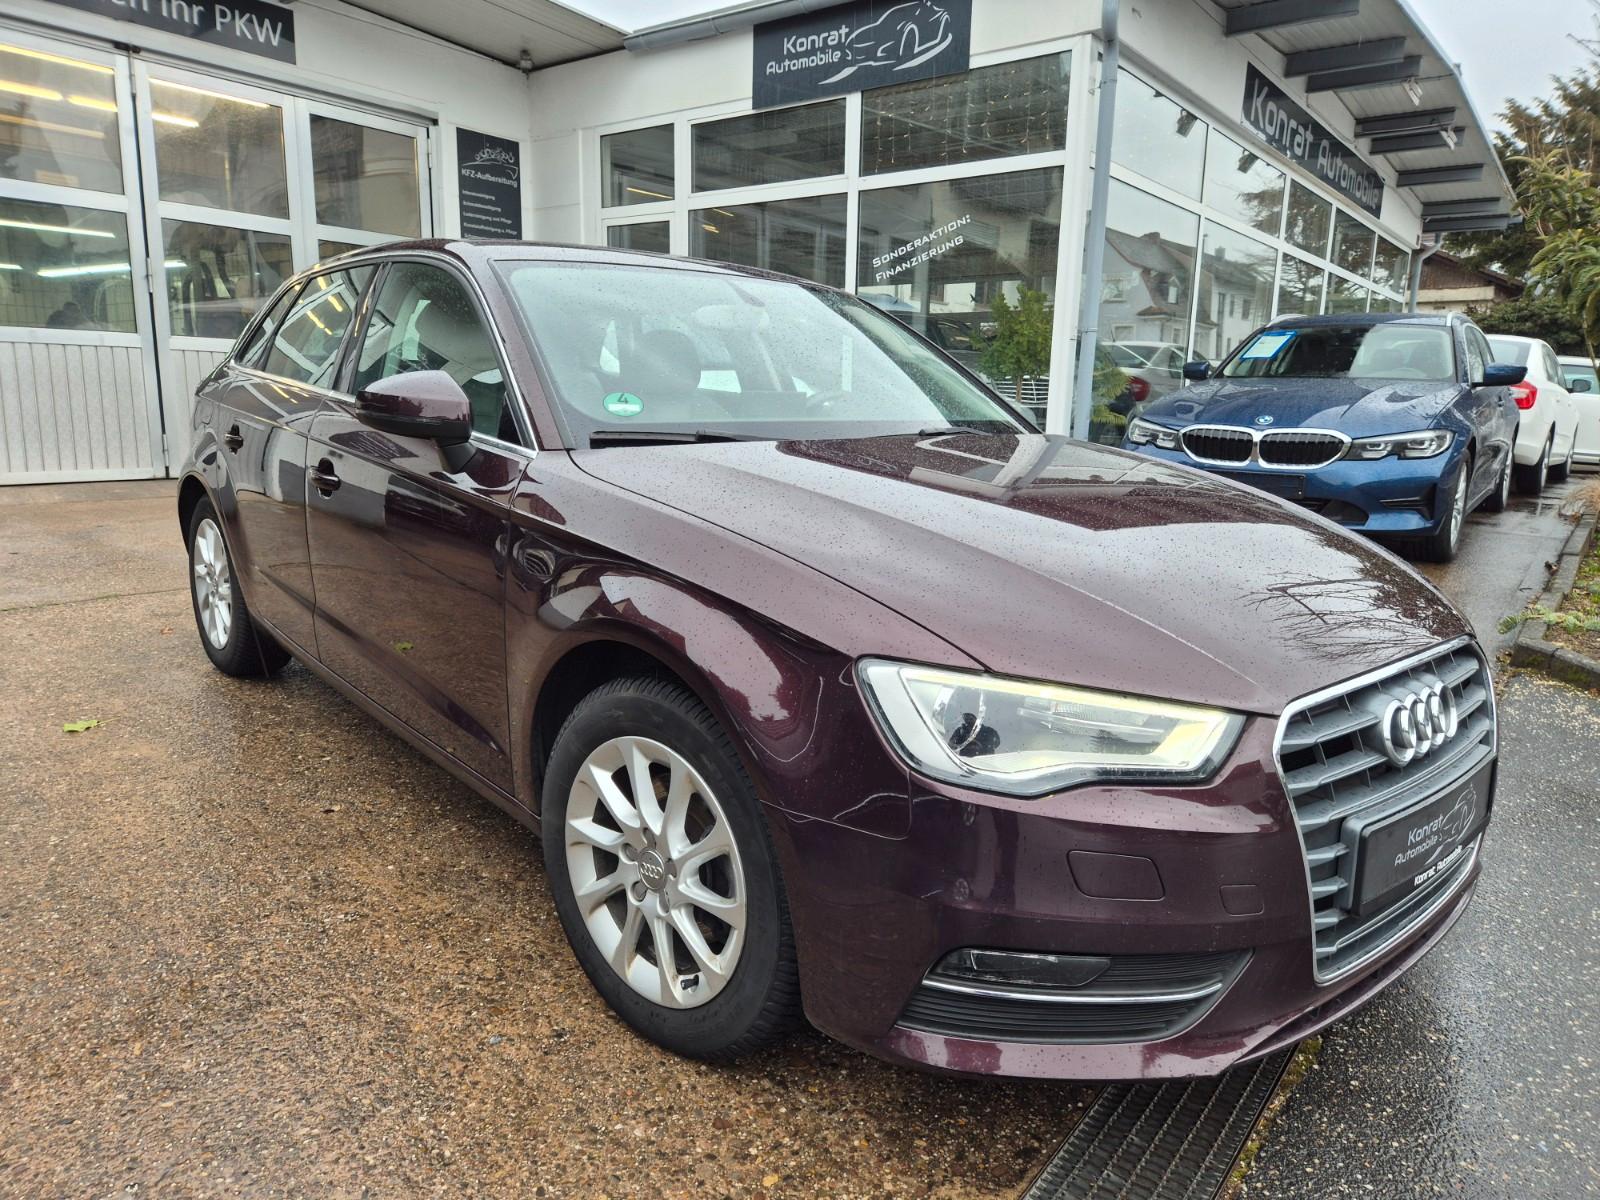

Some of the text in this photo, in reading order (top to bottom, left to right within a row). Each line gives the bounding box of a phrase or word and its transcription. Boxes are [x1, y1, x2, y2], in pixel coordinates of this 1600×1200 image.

[161, 0, 283, 47] Ihr PKW
[783, 24, 850, 55] Konrat
[766, 48, 842, 76] Automobile
[1250, 78, 1379, 210] Konrat Automobile
[617, 393, 629, 404] 4
[1407, 813, 1444, 846] Konrat
[1394, 834, 1438, 867] Automobile
